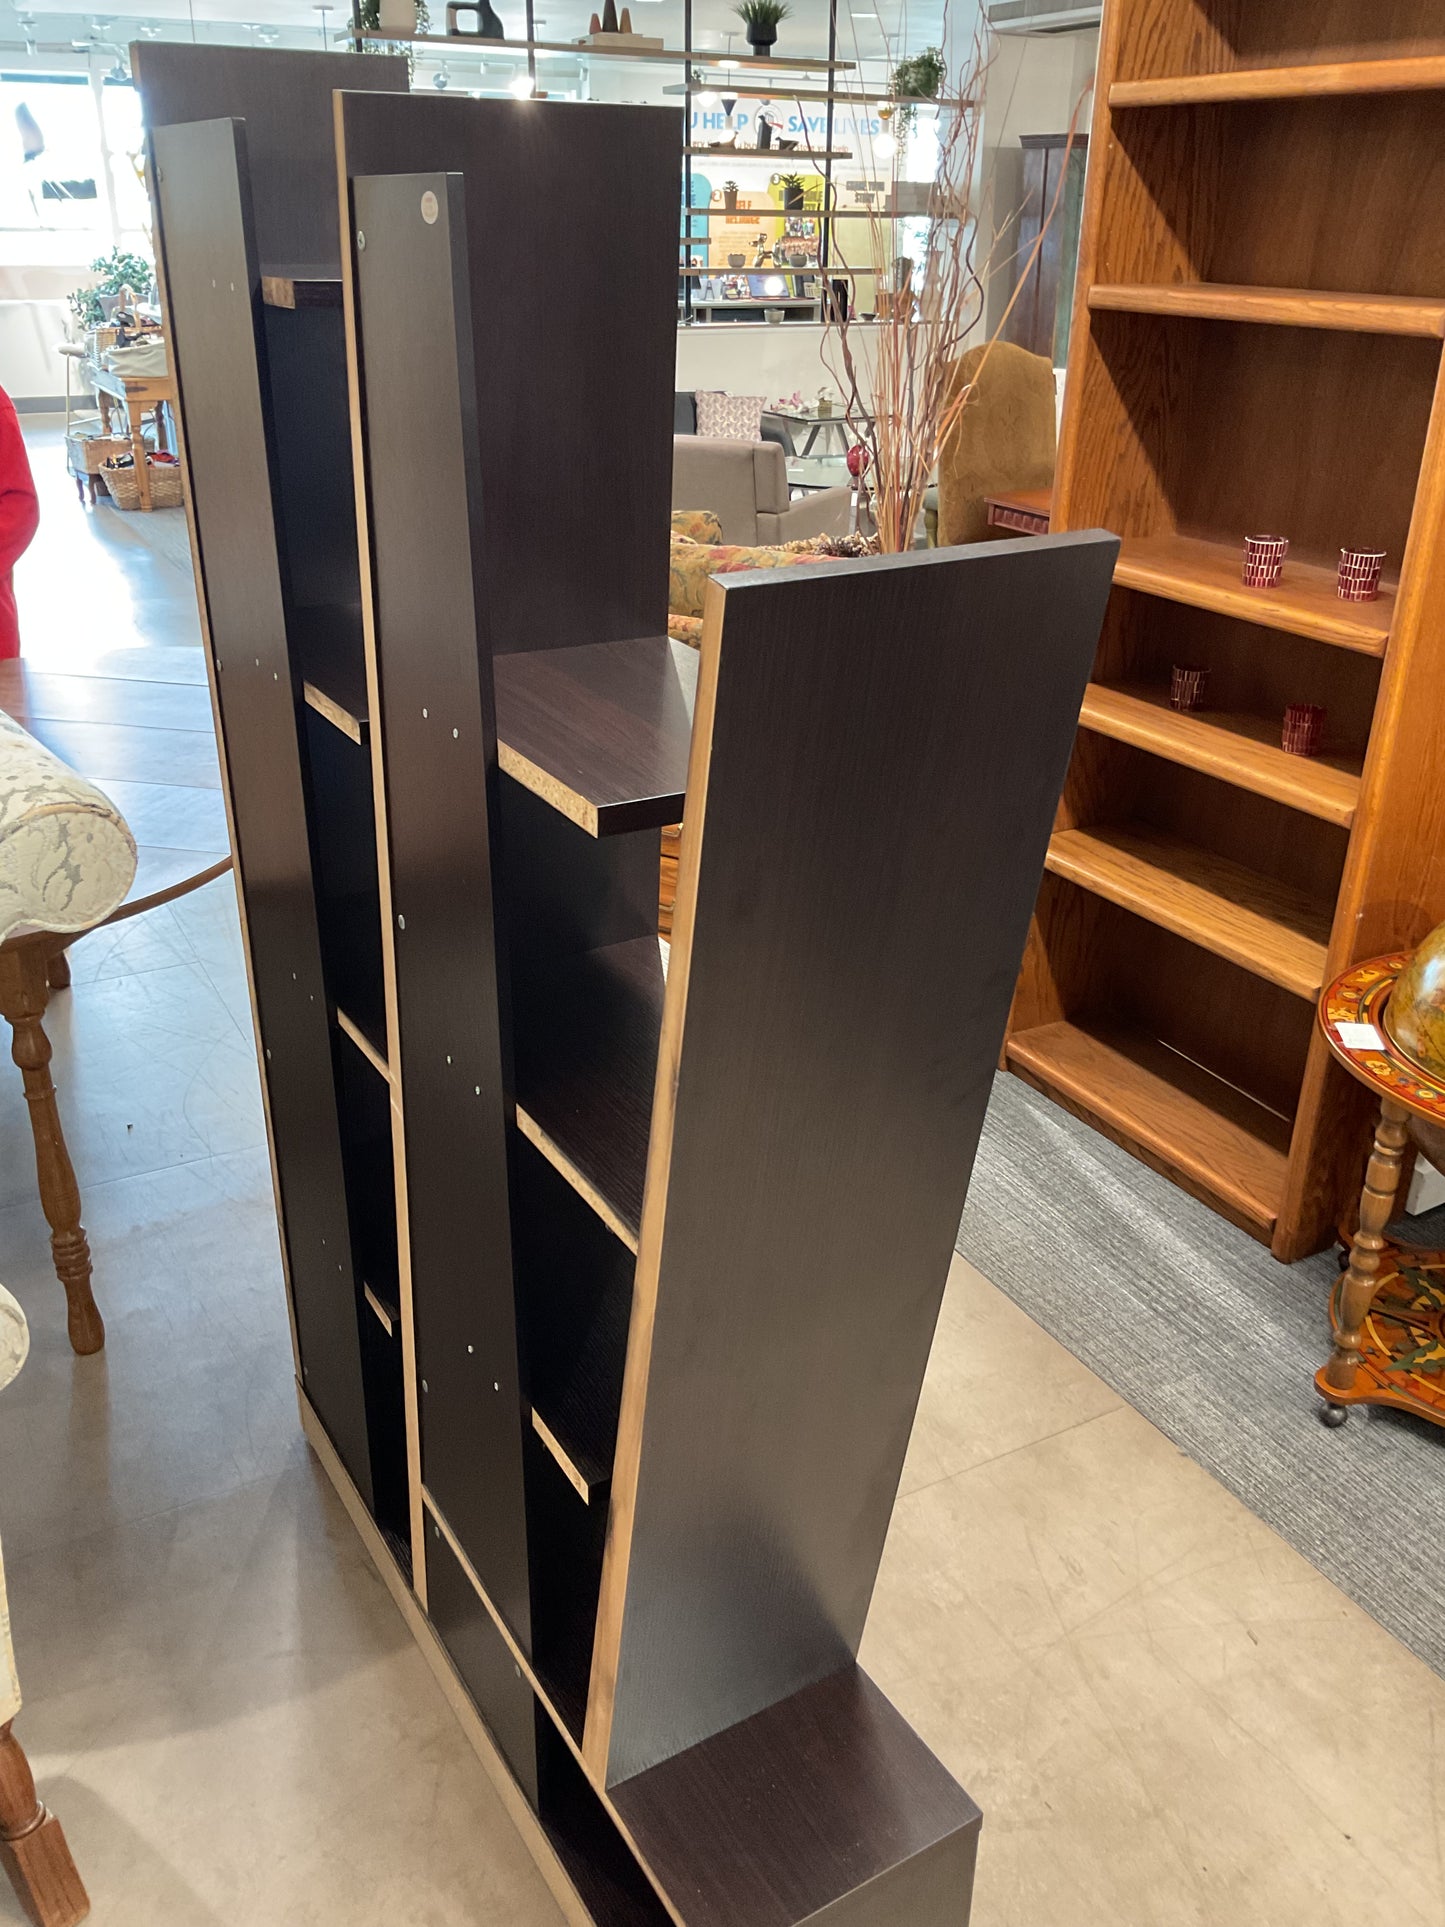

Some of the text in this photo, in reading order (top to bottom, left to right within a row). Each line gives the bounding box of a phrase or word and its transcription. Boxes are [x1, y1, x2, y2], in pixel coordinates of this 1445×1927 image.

[703, 113, 749, 129] HEP
[788, 115, 826, 133] SAVE
[834, 117, 880, 135] LIVES
